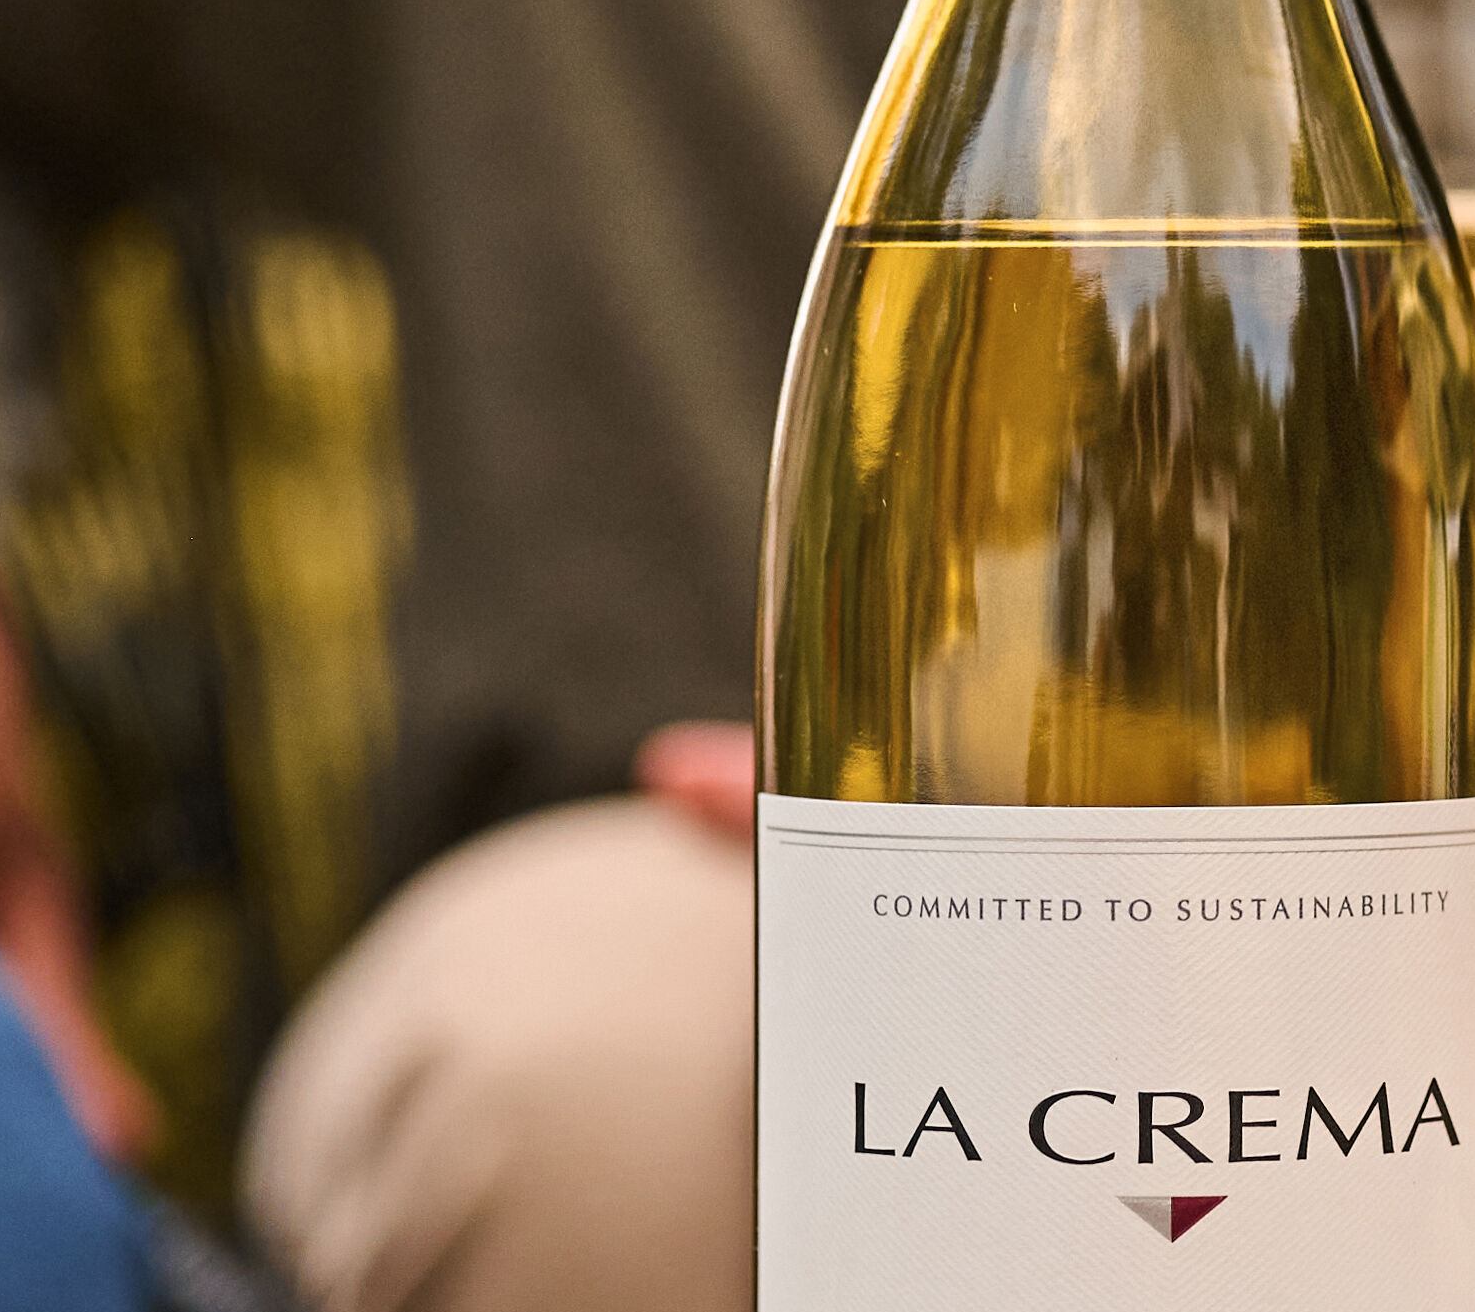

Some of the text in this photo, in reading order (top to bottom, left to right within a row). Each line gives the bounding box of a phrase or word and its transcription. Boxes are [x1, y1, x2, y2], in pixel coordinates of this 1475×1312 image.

[874, 890, 1450, 923] COMMITTED TO SUSTAINABILITY
[854, 1077, 1461, 1166] LA CREMA
